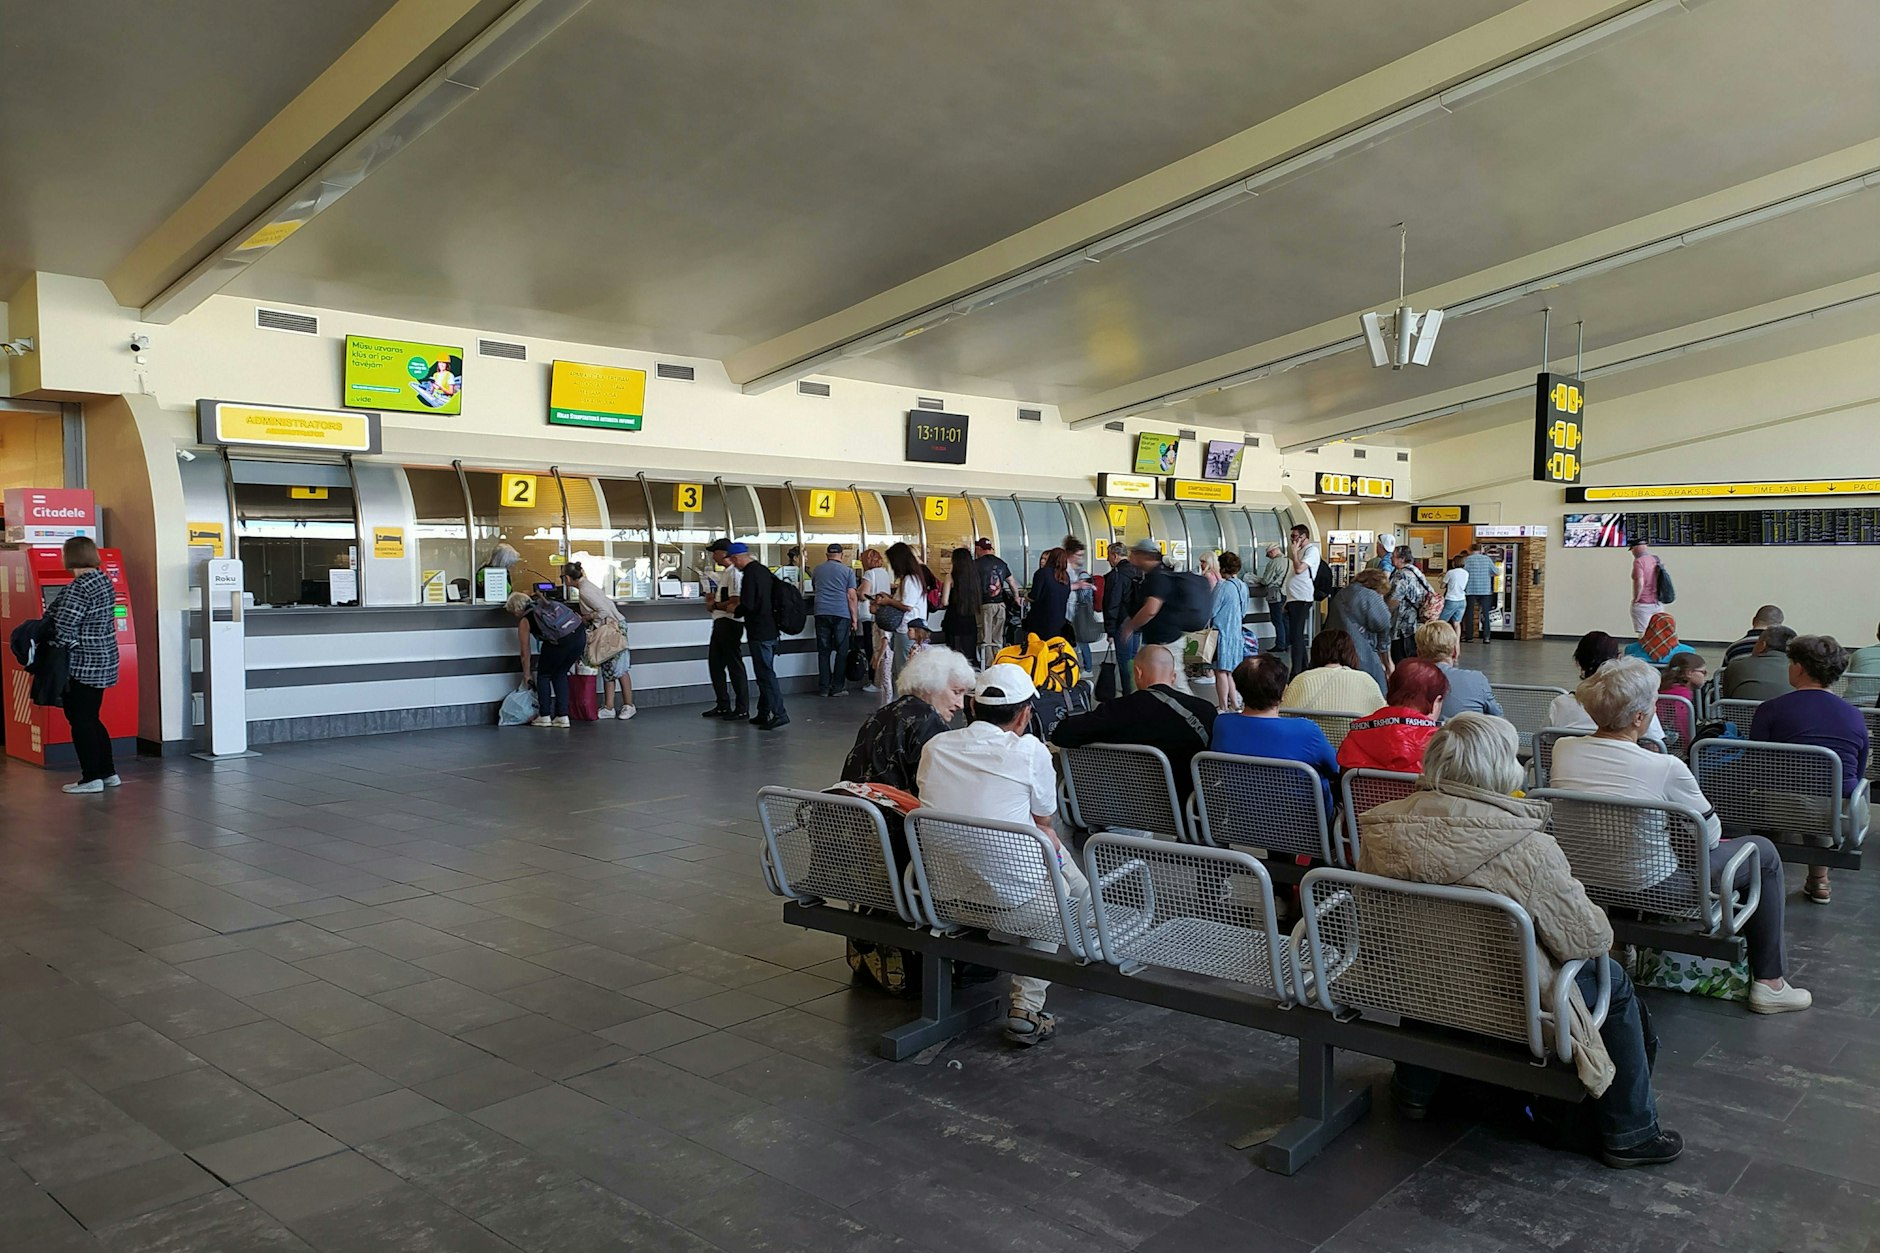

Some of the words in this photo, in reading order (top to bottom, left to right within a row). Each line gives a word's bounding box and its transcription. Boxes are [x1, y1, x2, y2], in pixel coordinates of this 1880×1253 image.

[246, 416, 343, 431] ADMINISTRATORS
[917, 425, 962, 443] 13:11:01
[513, 480, 529, 502] 2
[1662, 488, 1712, 496] SARAKSTS
[1779, 485, 1809, 493] TABLE
[684, 487, 697, 508] 3
[819, 495, 830, 513] 4
[33, 507, 86, 518] Citadele
[935, 500, 944, 516] 5
[1117, 508, 1124, 522] 7
[1373, 716, 1401, 728] FASHION
[1405, 717, 1436, 727] FASHION
